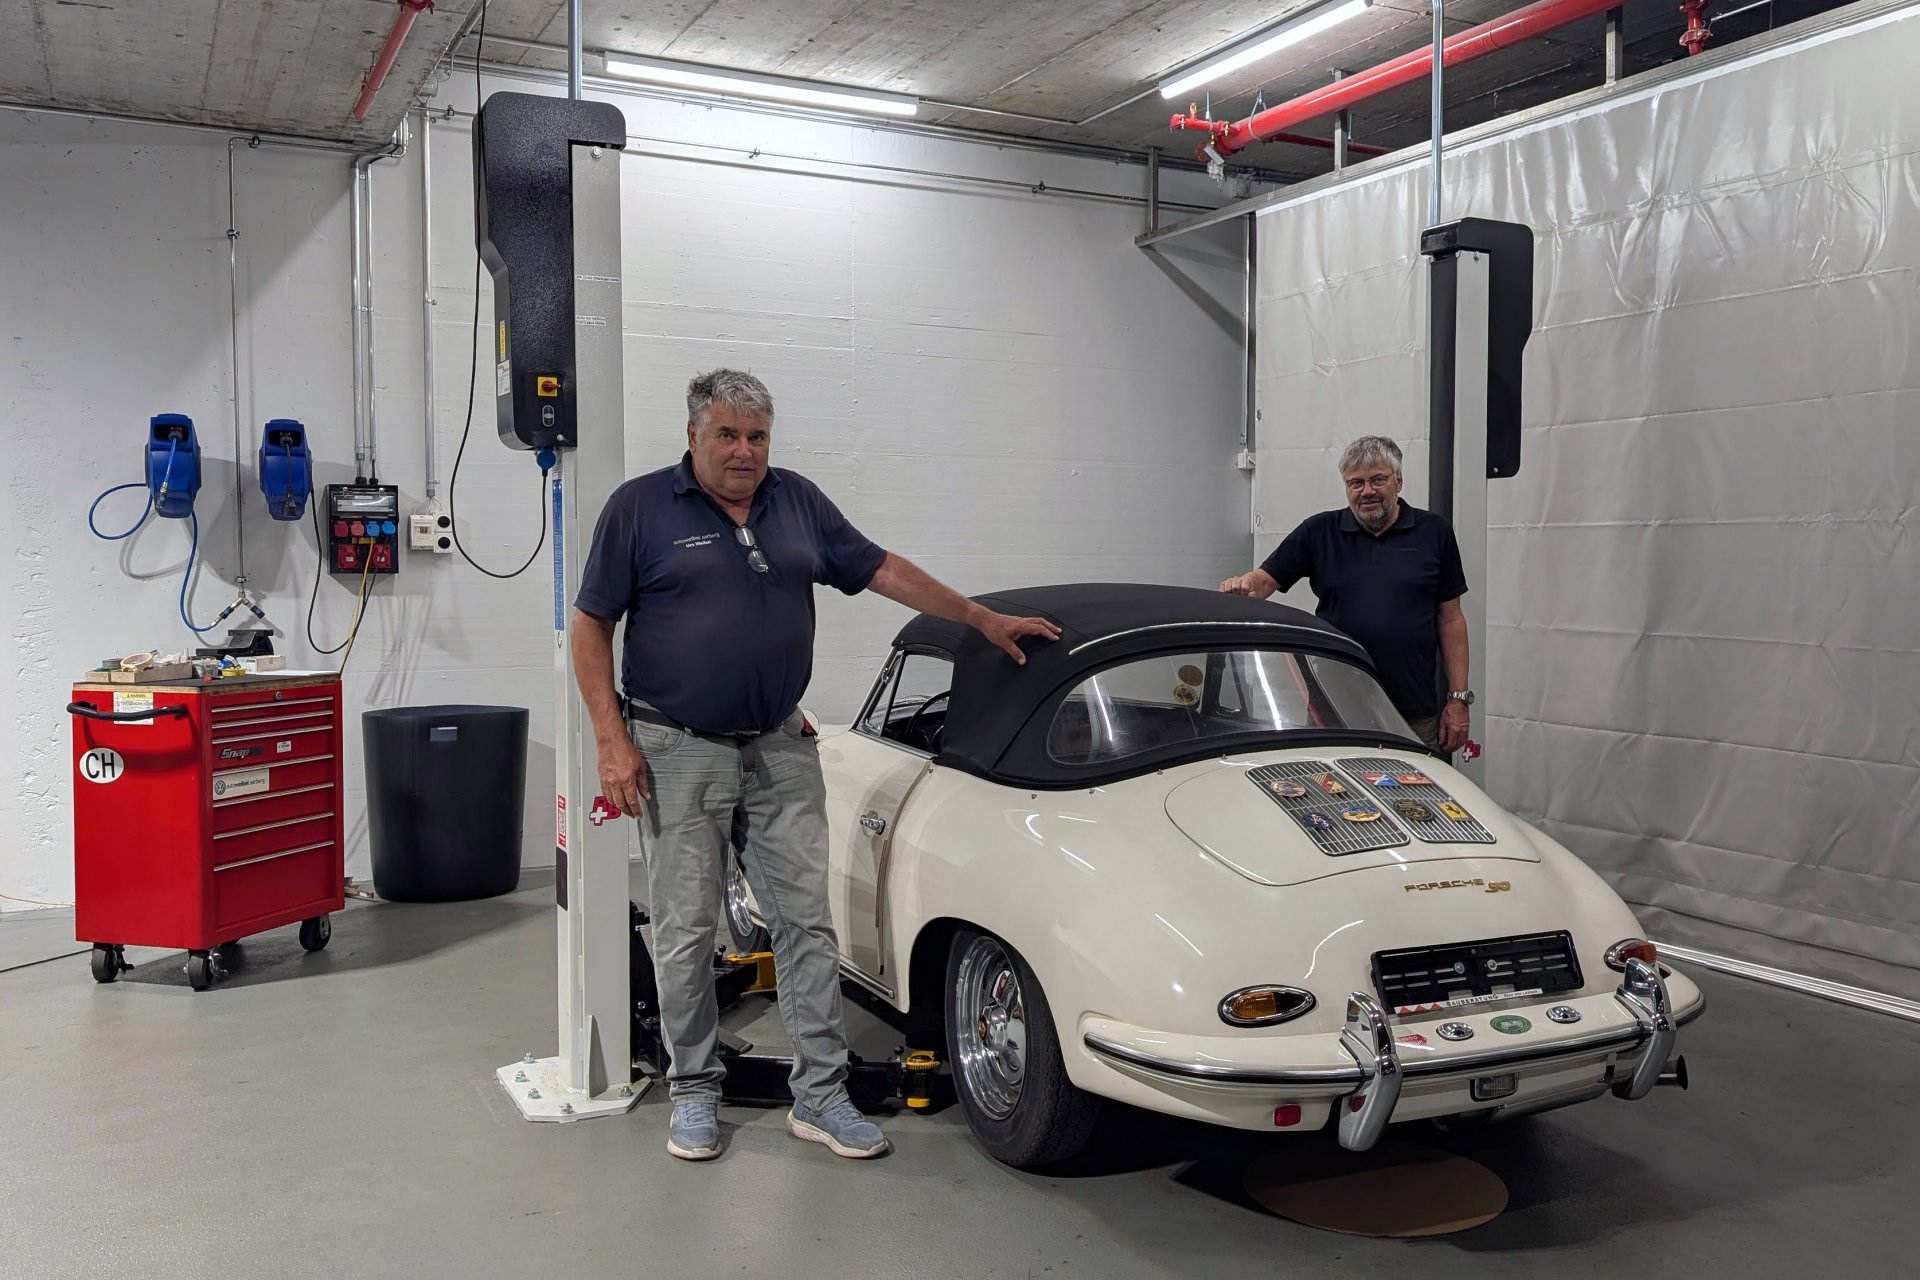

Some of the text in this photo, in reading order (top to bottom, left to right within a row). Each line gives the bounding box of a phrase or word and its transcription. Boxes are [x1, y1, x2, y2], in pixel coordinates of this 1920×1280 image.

[86, 752, 115, 778] CH
[1404, 879, 1511, 893] PORSCHE 90
[1446, 994, 1498, 1006] BAUBERATUNG
